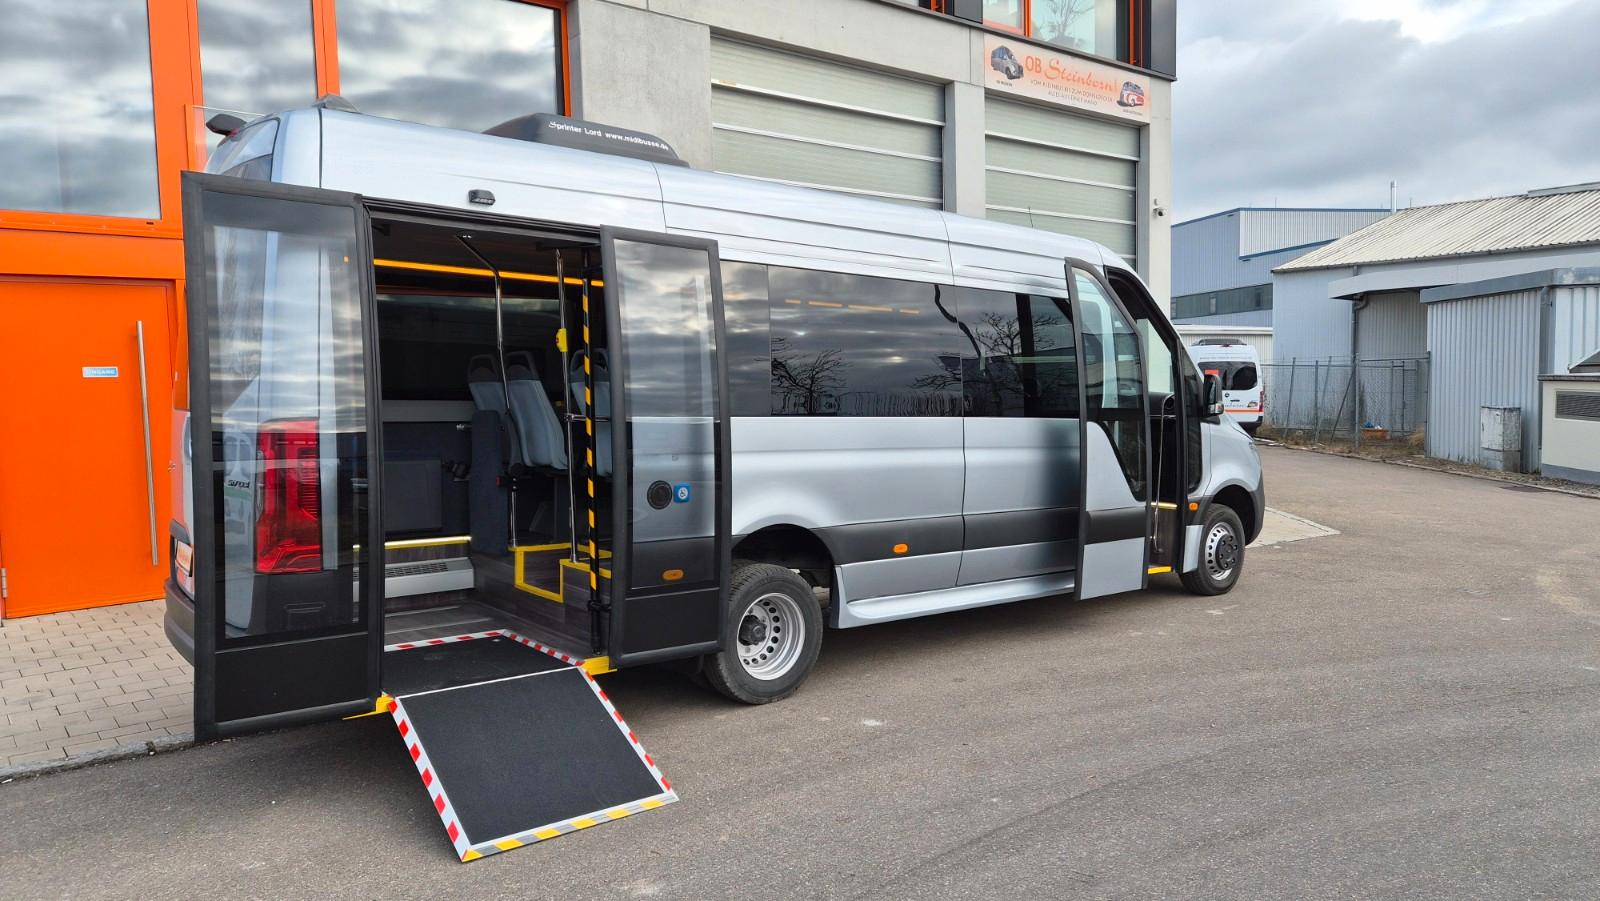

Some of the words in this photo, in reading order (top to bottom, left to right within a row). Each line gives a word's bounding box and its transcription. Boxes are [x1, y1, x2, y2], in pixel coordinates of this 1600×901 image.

[1025, 56, 1041, 73] OB
[548, 121, 582, 133] Sprinter
[584, 127, 602, 137] Lord
